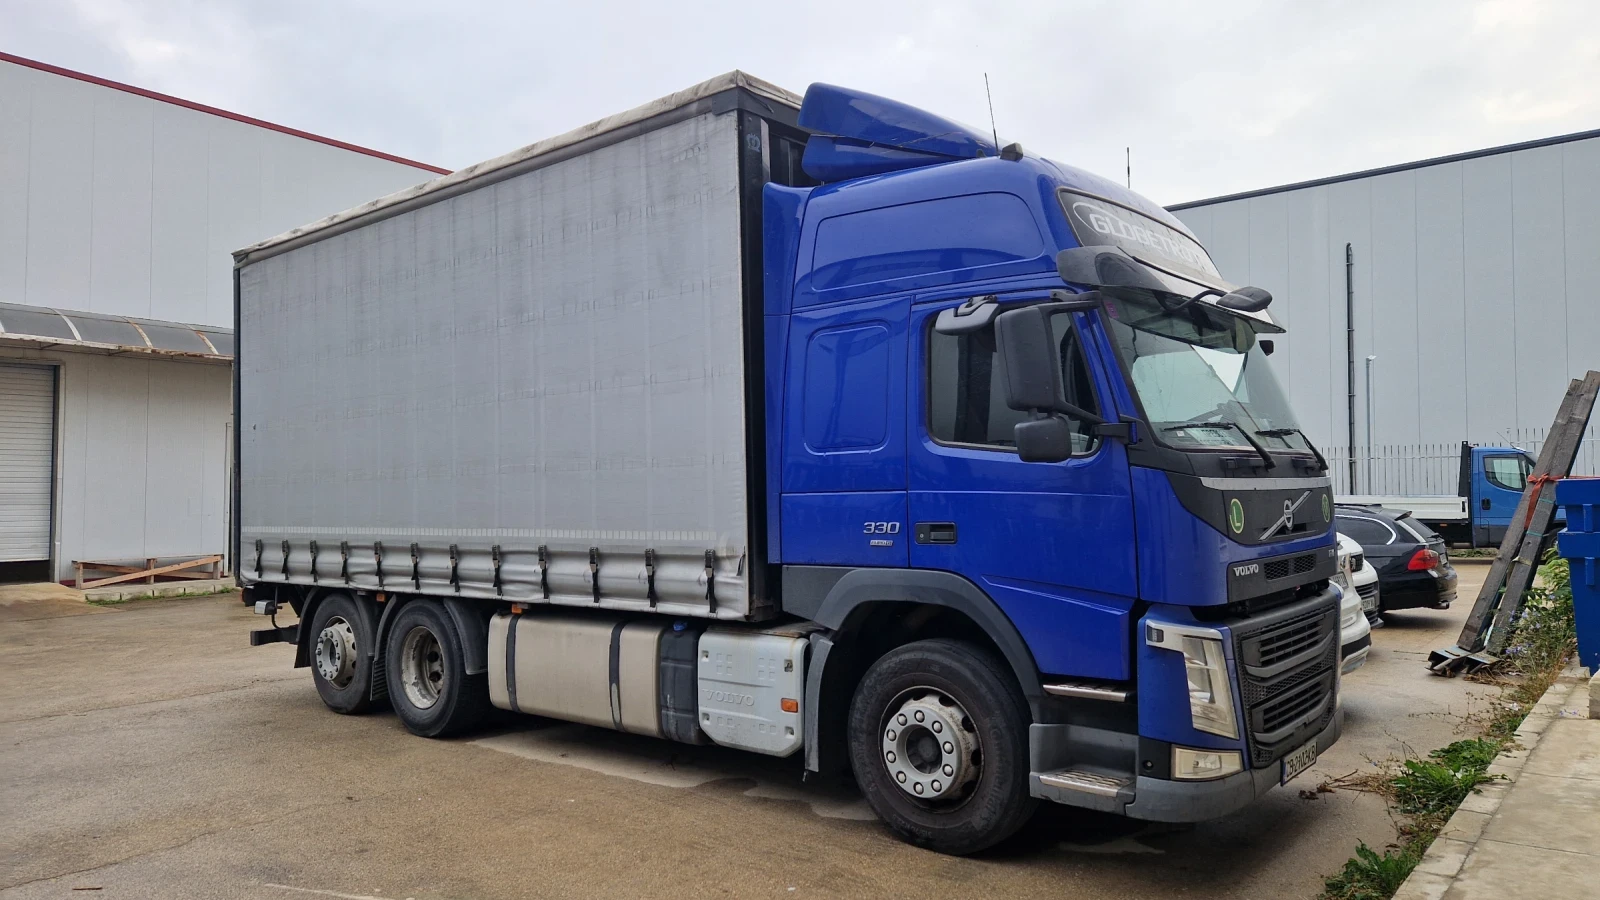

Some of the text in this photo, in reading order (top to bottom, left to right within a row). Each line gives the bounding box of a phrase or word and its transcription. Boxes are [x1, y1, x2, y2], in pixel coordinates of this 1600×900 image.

[1233, 506, 1241, 526] L
[863, 522, 900, 534] 330
[1233, 564, 1259, 577] VOLVO
[701, 688, 755, 706] VOLVO
